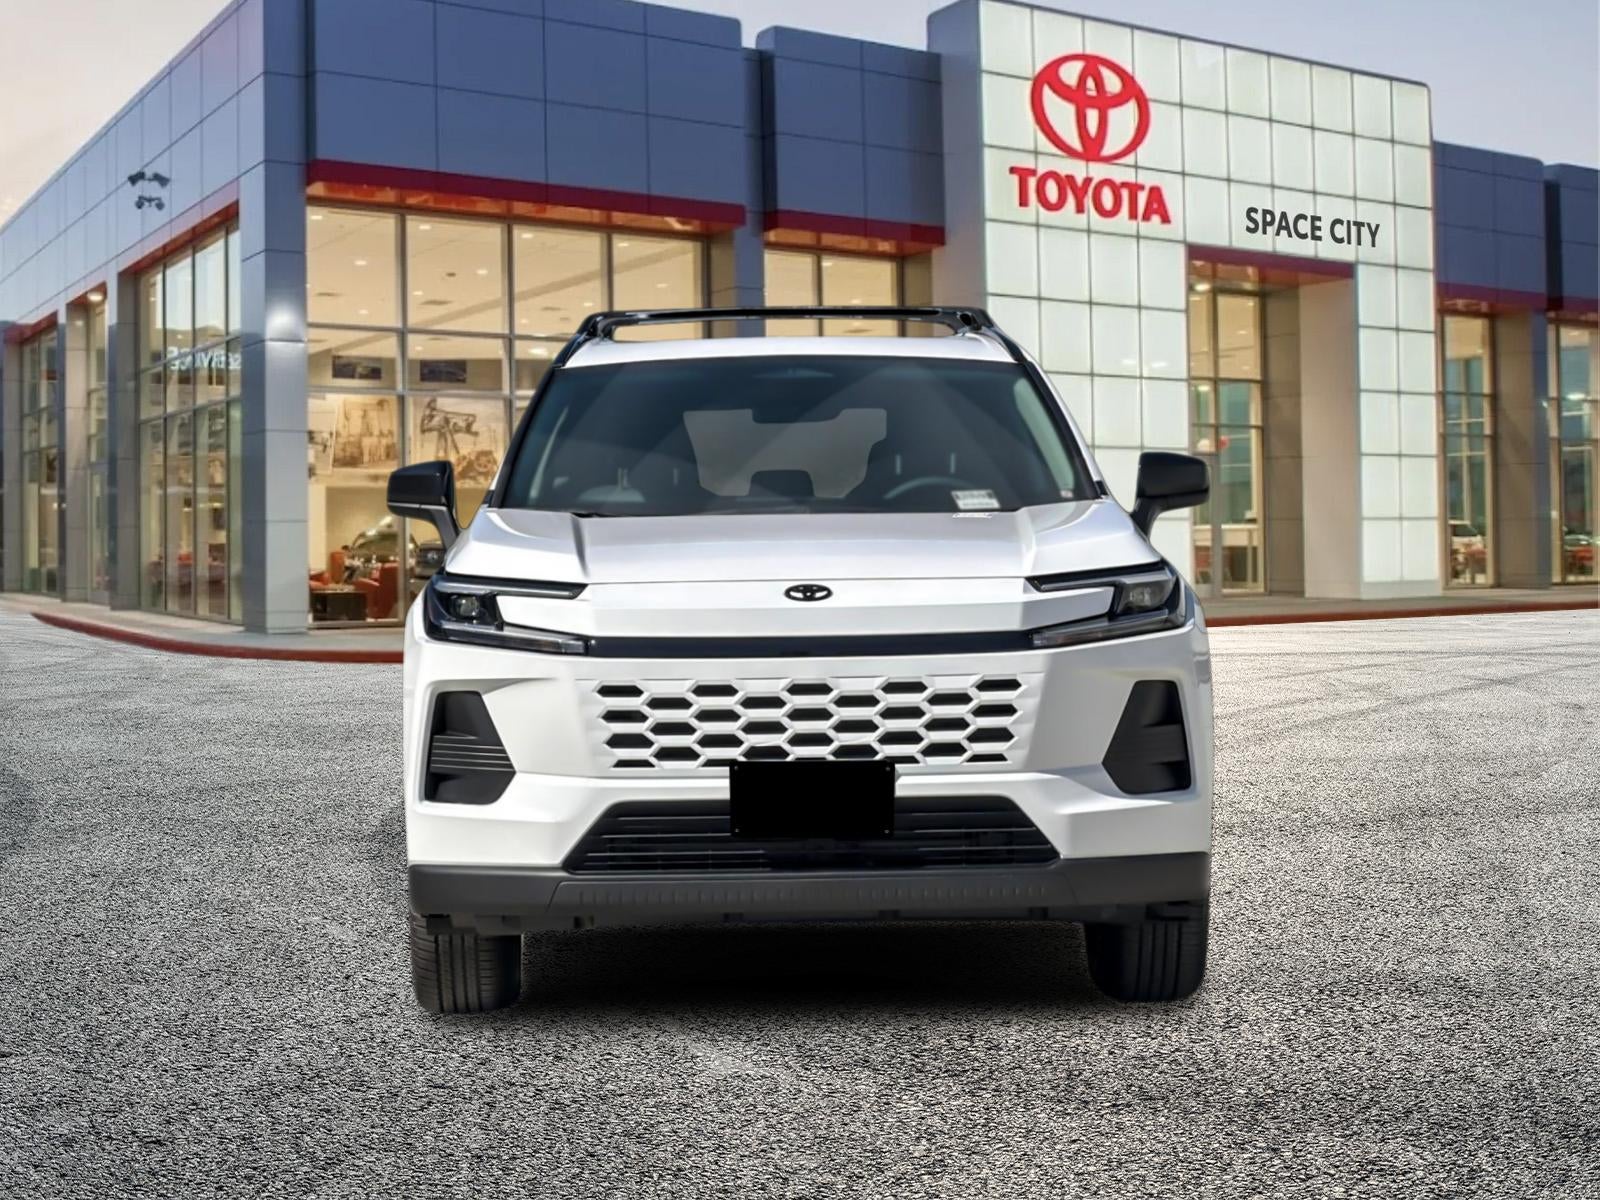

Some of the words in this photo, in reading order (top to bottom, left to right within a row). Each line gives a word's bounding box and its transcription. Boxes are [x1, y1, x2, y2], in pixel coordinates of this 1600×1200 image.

[1010, 166, 1171, 224] TOYOTA
[1245, 207, 1322, 241] SPACE
[1329, 218, 1381, 247] CITY
